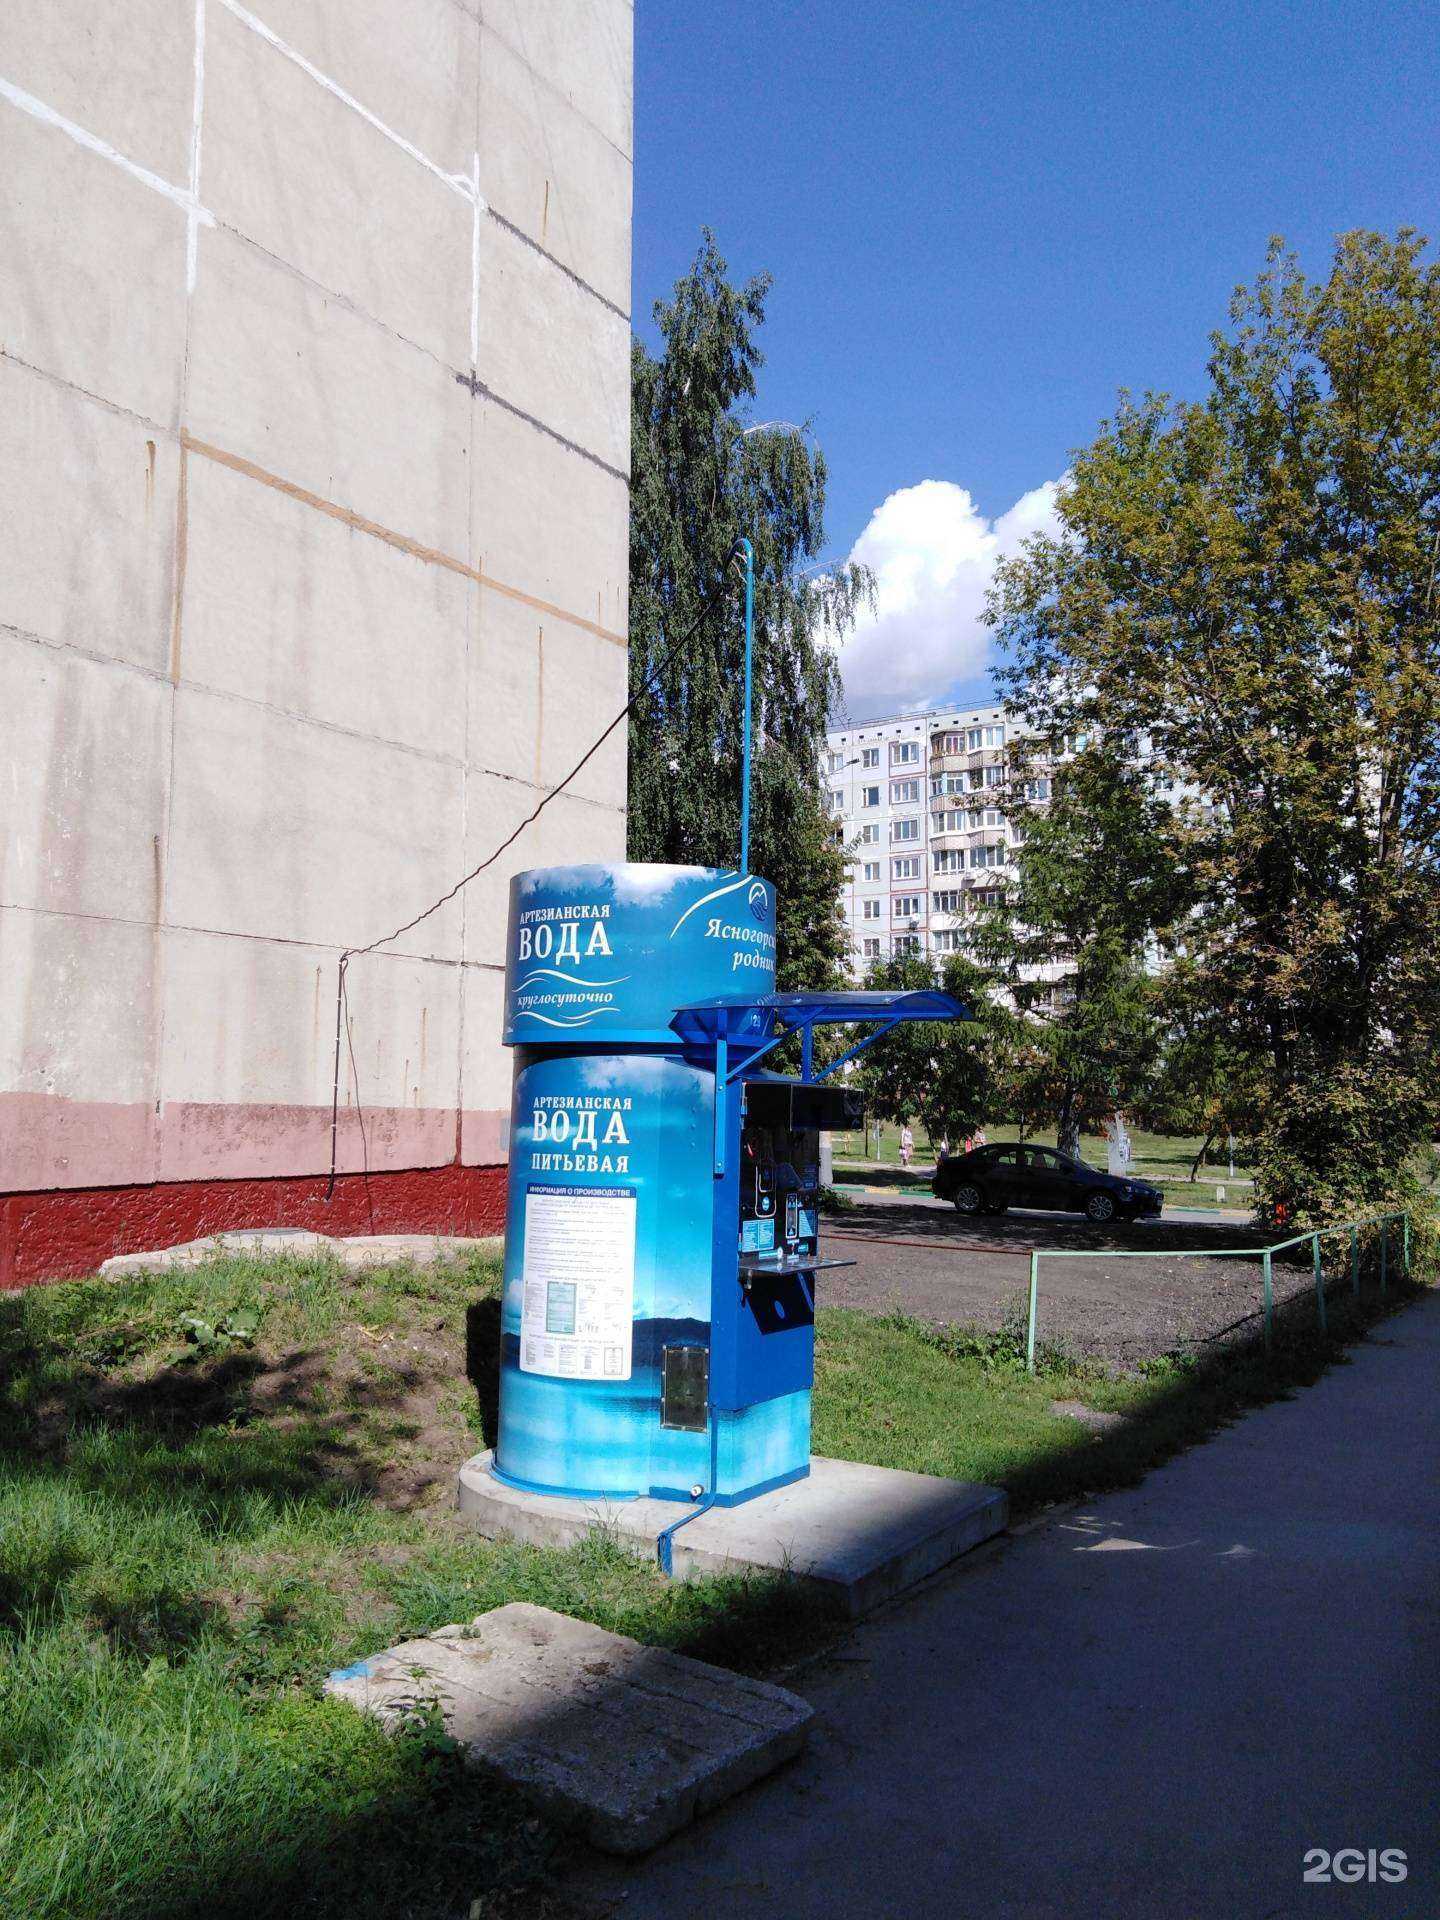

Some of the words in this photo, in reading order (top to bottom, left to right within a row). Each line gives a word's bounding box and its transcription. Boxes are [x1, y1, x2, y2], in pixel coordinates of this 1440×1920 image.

[520, 904, 610, 924] АРТЕЗИАНСКАЯ
[518, 920, 613, 966] ВОДА
[517, 992, 613, 1009] круглосуточно
[533, 1096, 632, 1110] АРТЕЗИАНСКАЯ
[532, 1110, 630, 1151] ВОДА
[531, 1153, 629, 1173] ПИТЬЕВАЯ
[529, 1186, 567, 1194] ИНФОРМАЦИЯ
[574, 1188, 631, 1197] ПРОИЗВОДСТВЕ
